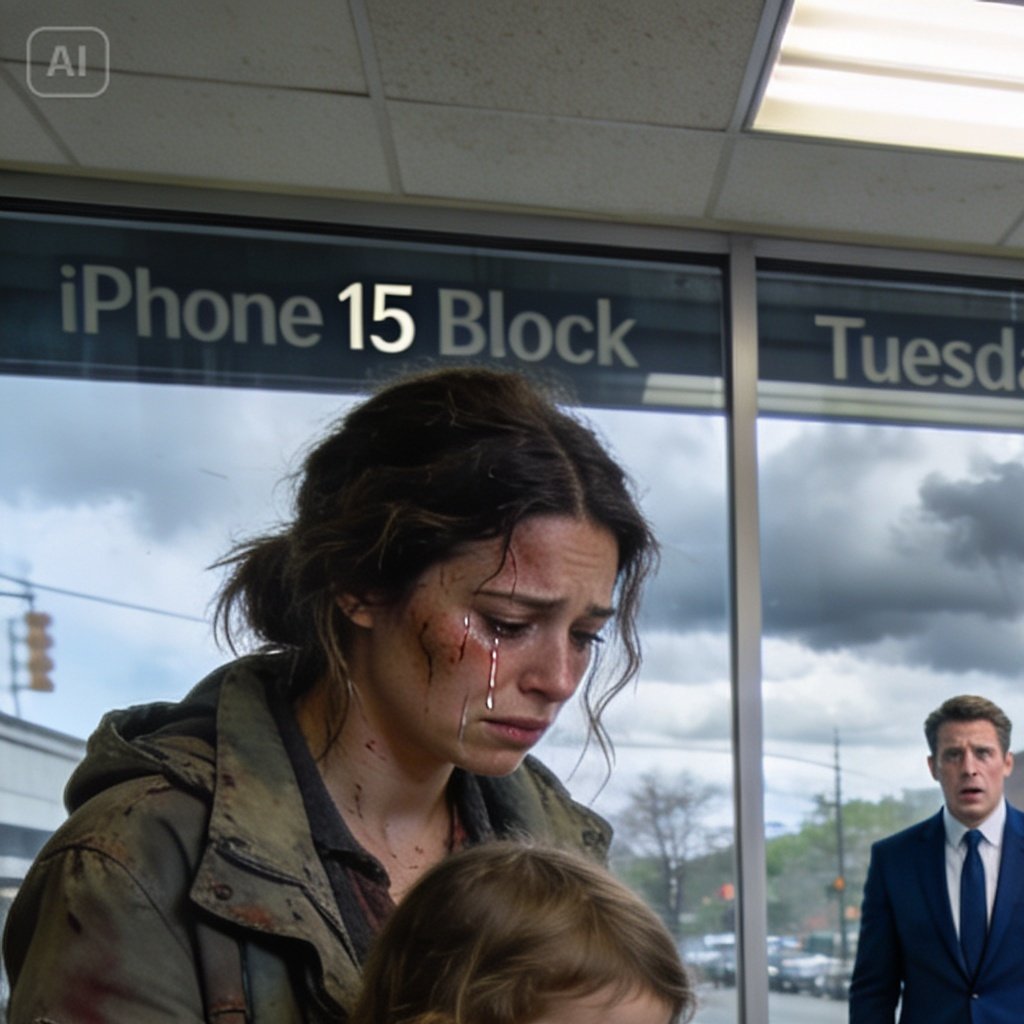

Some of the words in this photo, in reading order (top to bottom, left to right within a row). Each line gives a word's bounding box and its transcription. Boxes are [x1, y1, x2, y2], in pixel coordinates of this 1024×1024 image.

[60, 265, 323, 348] iPhone
[338, 282, 415, 353] 15
[438, 288, 637, 367] Block
